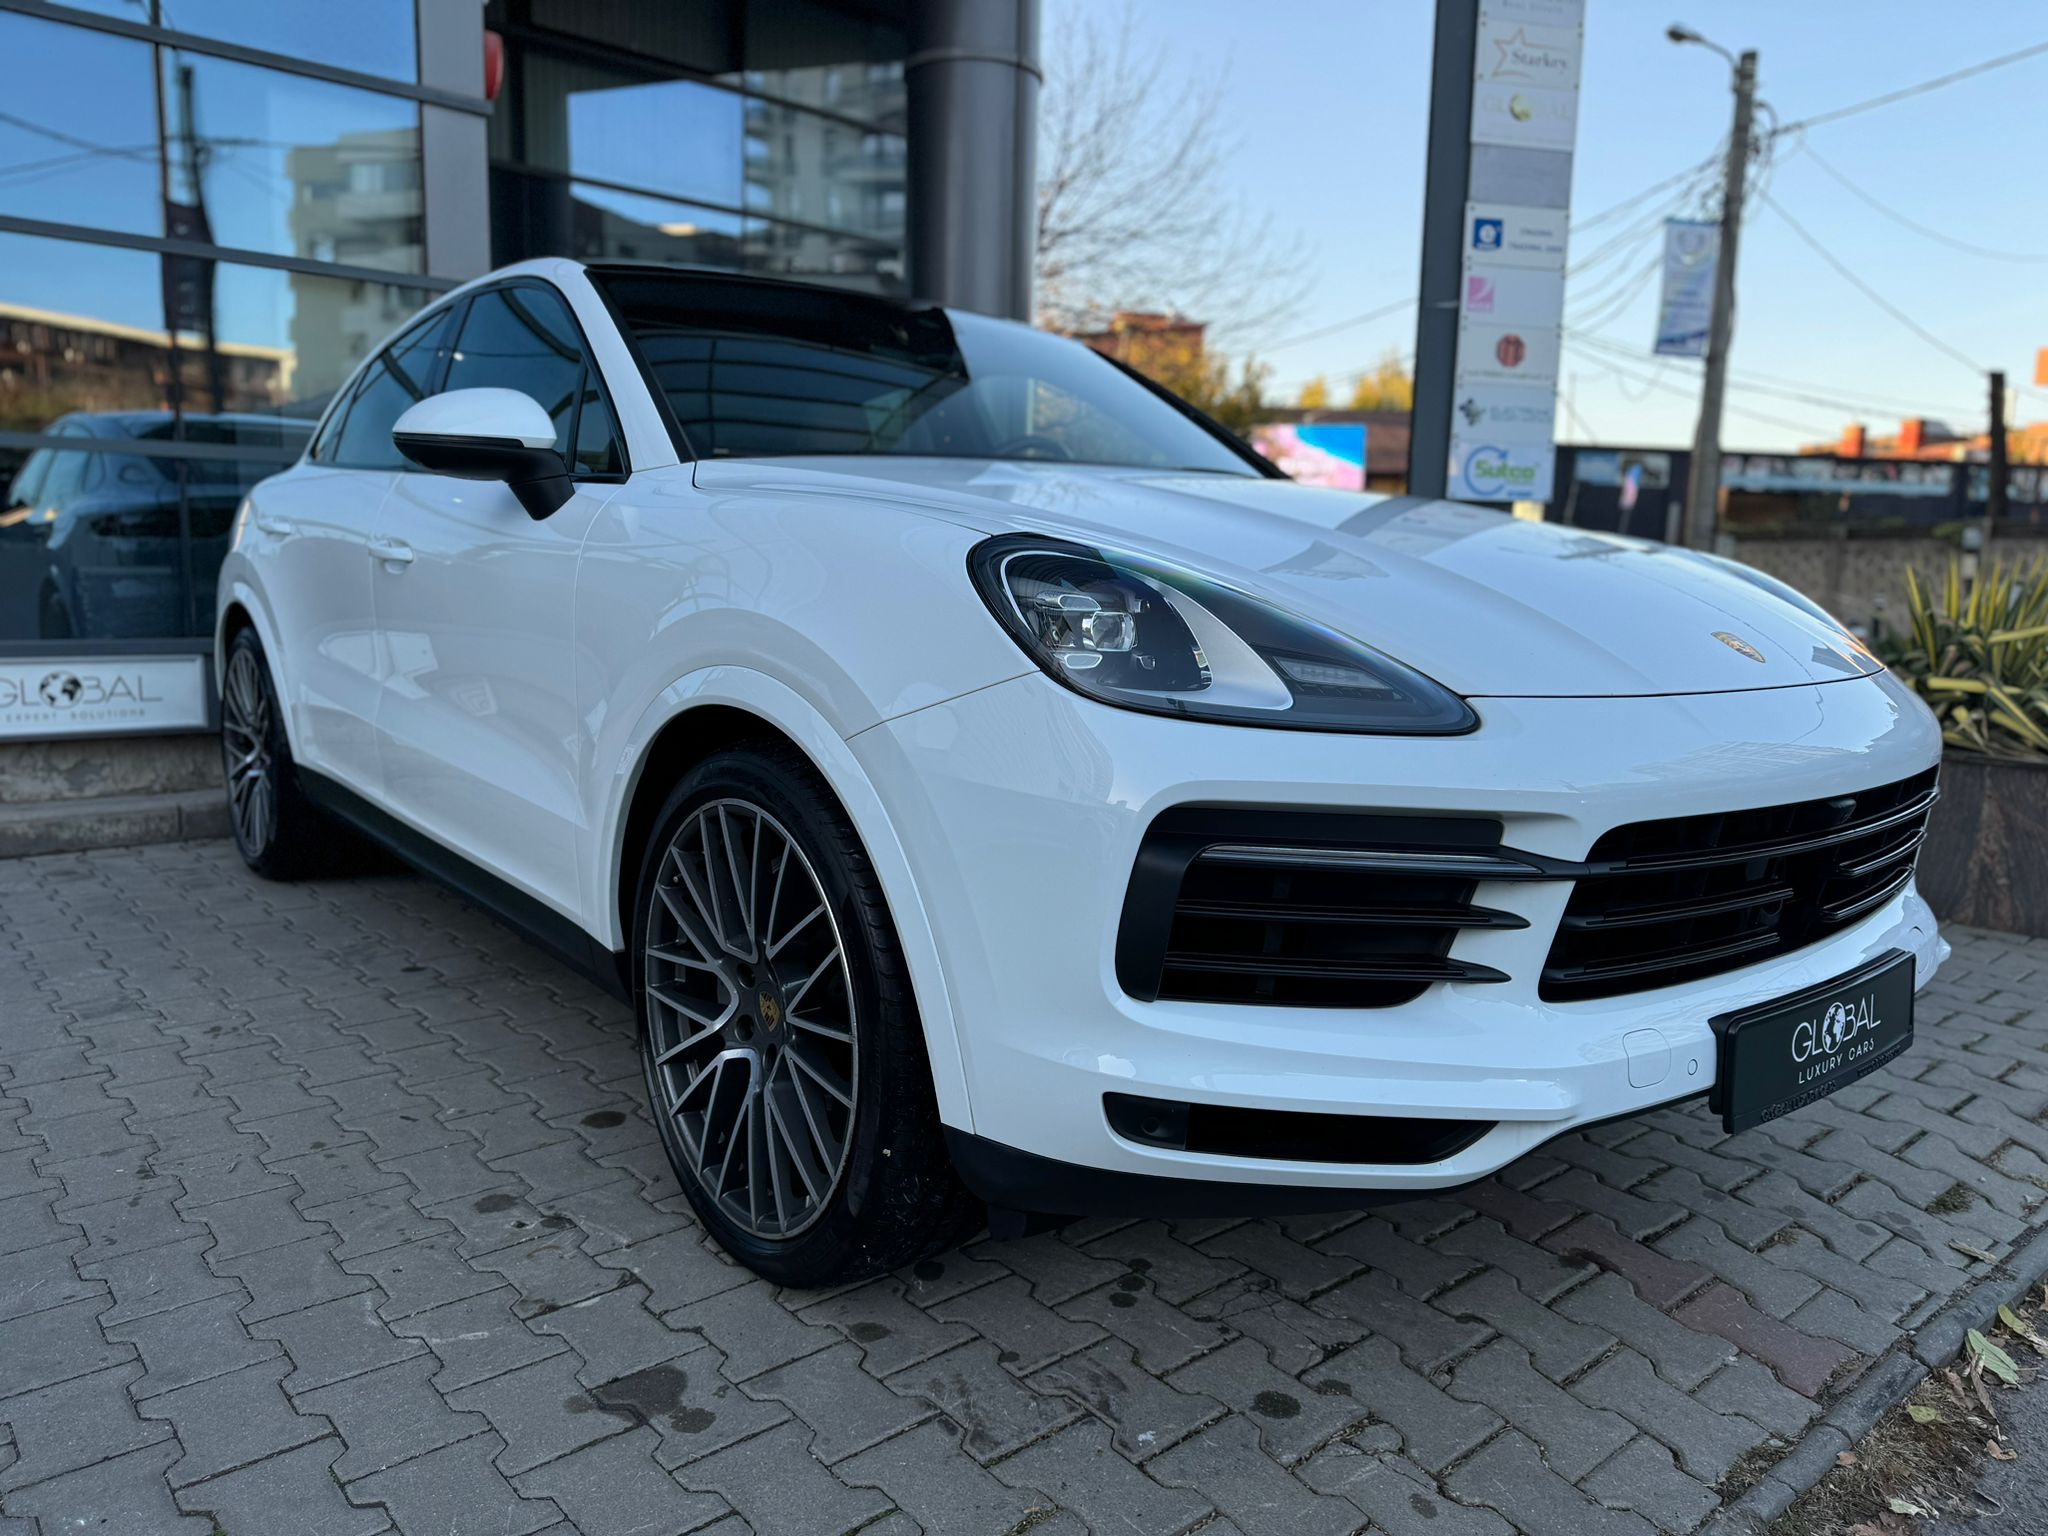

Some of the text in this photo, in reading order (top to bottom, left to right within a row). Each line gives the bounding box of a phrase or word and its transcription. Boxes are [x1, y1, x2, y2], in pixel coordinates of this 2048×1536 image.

[1511, 49, 1568, 75] Starkey
[71, 708, 146, 721] SOLUTIONS
[1792, 994, 1881, 1062] GLOBAL
[1798, 1053, 1843, 1085] LUXURY
[1849, 1038, 1875, 1061] CARS
